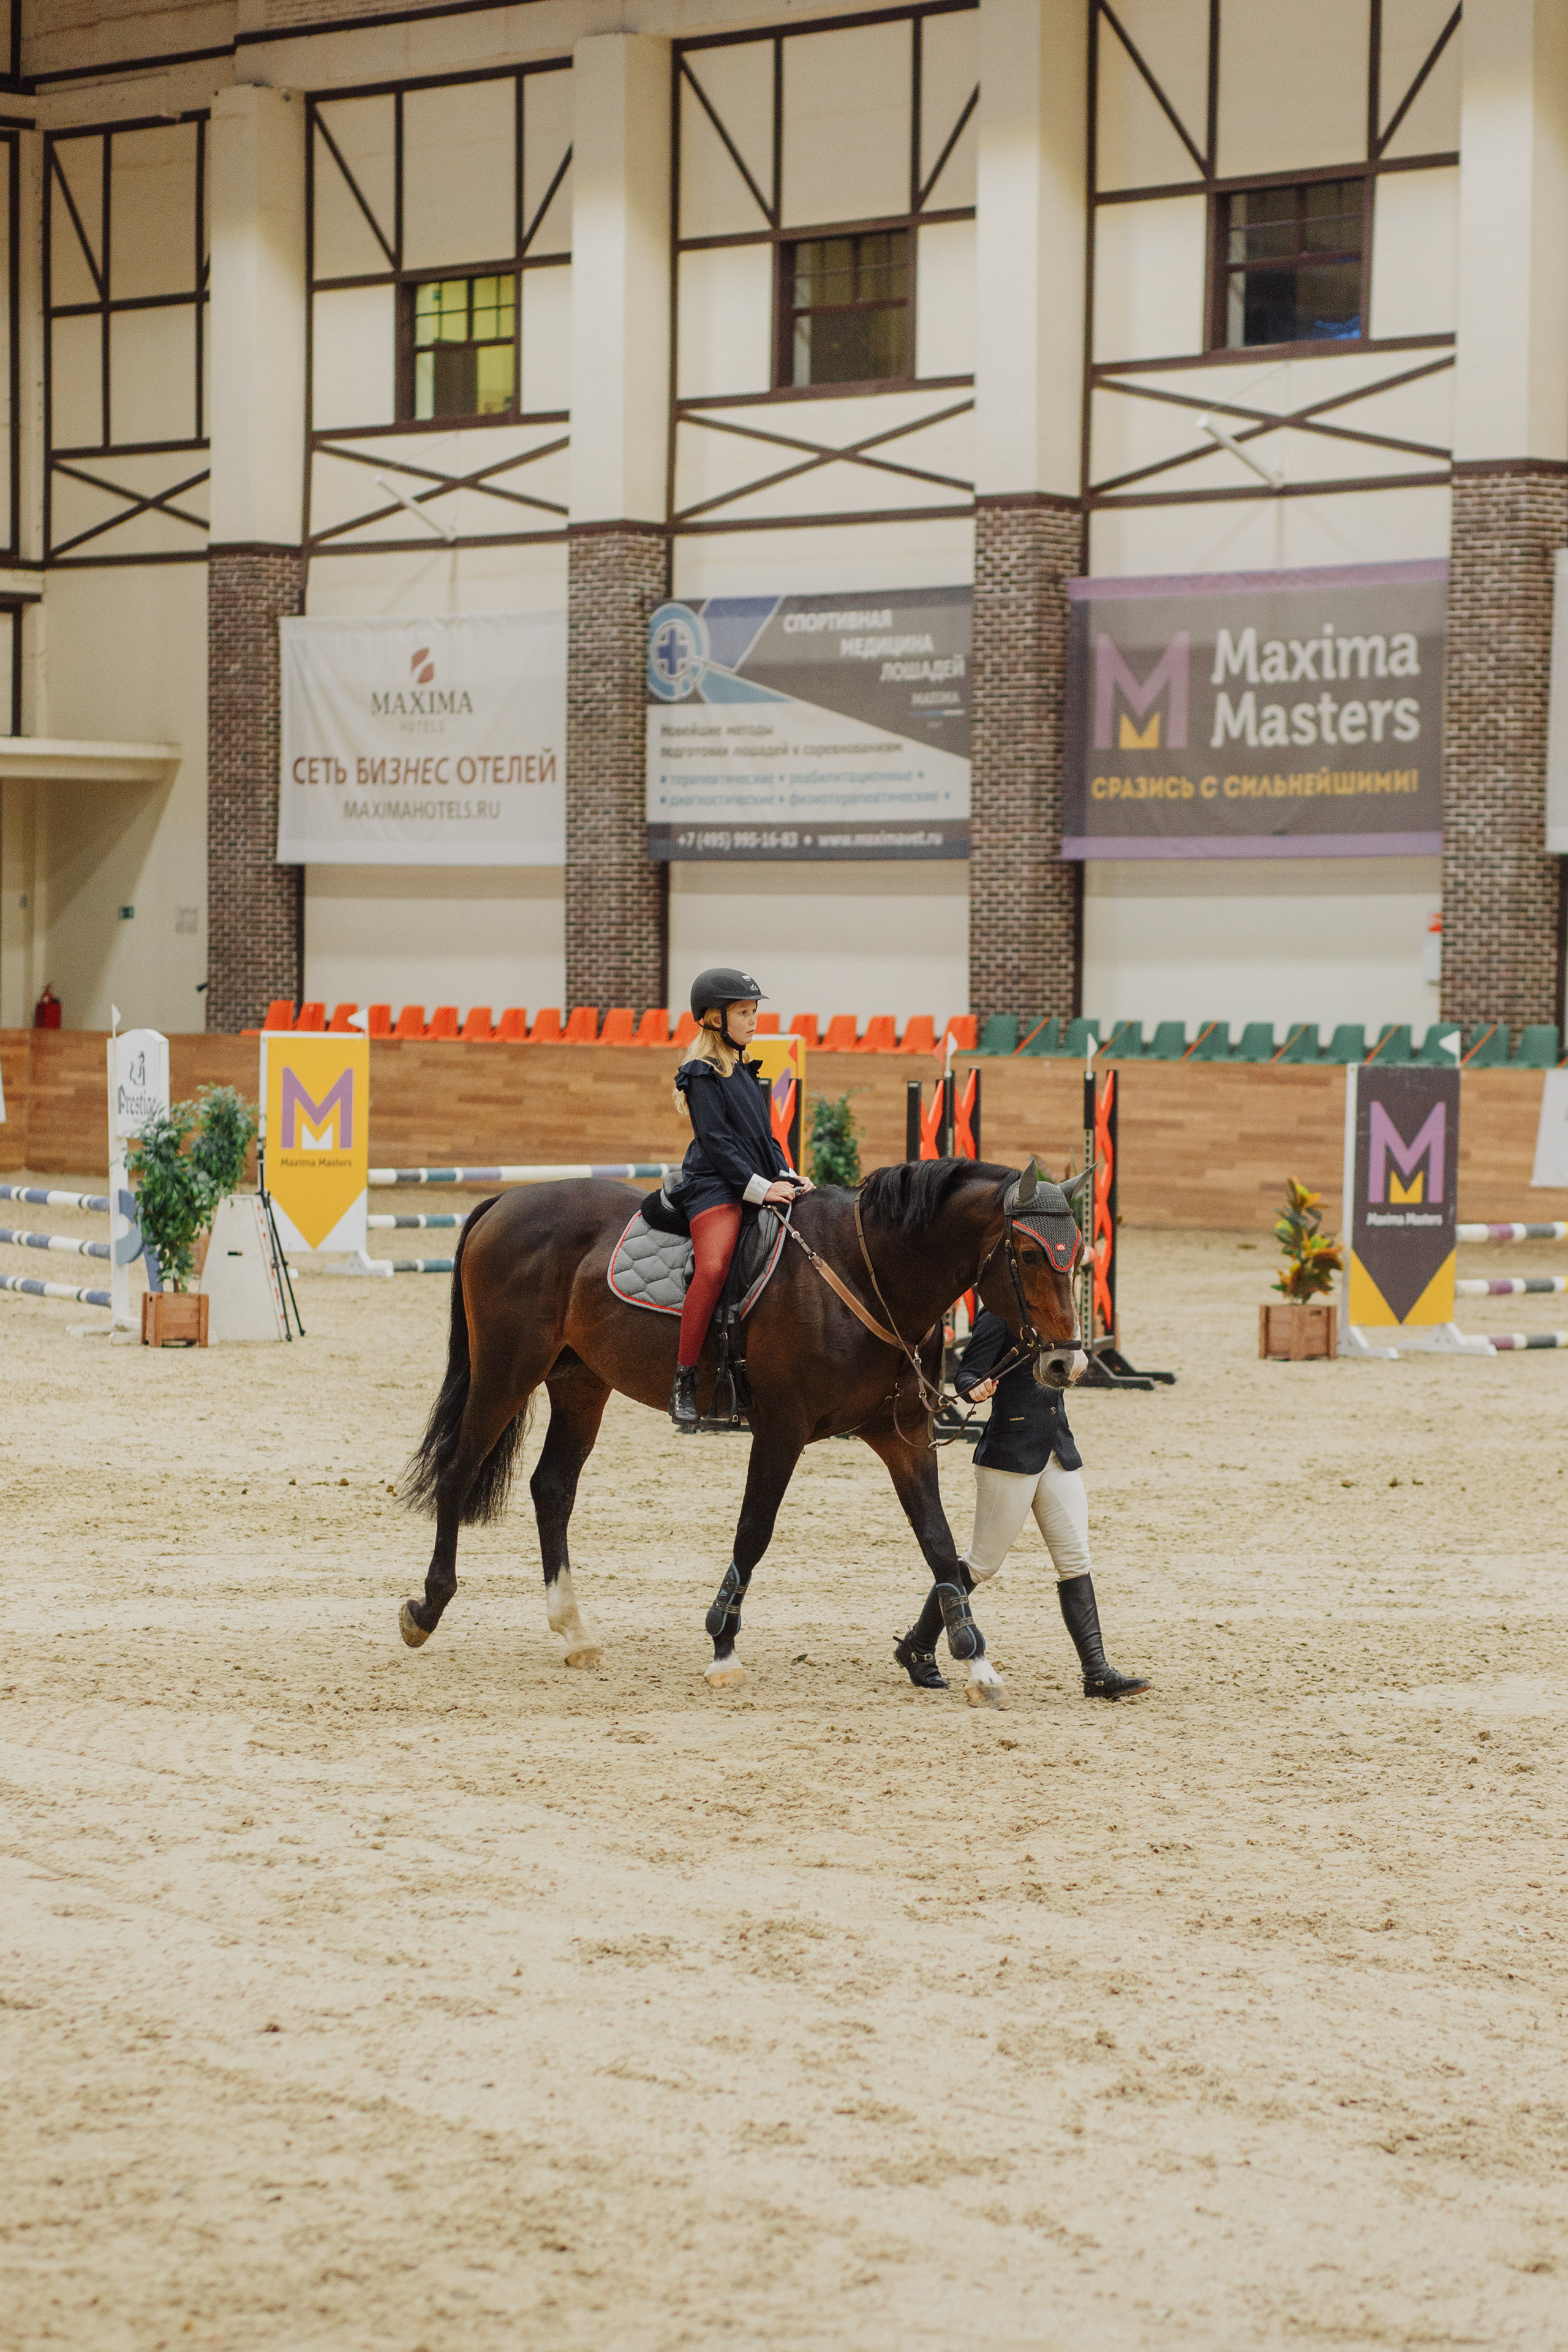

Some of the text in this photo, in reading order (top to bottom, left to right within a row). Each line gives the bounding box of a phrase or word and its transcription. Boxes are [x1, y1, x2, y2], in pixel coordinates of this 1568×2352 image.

[1210, 624, 1420, 685] Maxima
[371, 690, 473, 715] MAXIMA
[1210, 692, 1421, 748] Masters
[292, 747, 557, 786] СЕТЬ БИЗНЕС ОТЕЛЕЙ
[1091, 767, 1419, 799] СРАЗИСЬ С СИЛЬНЕЙШИМИ!
[343, 800, 501, 820] MAXIMAHOTELS.RU
[281, 1158, 352, 1166] Maxima Masters
